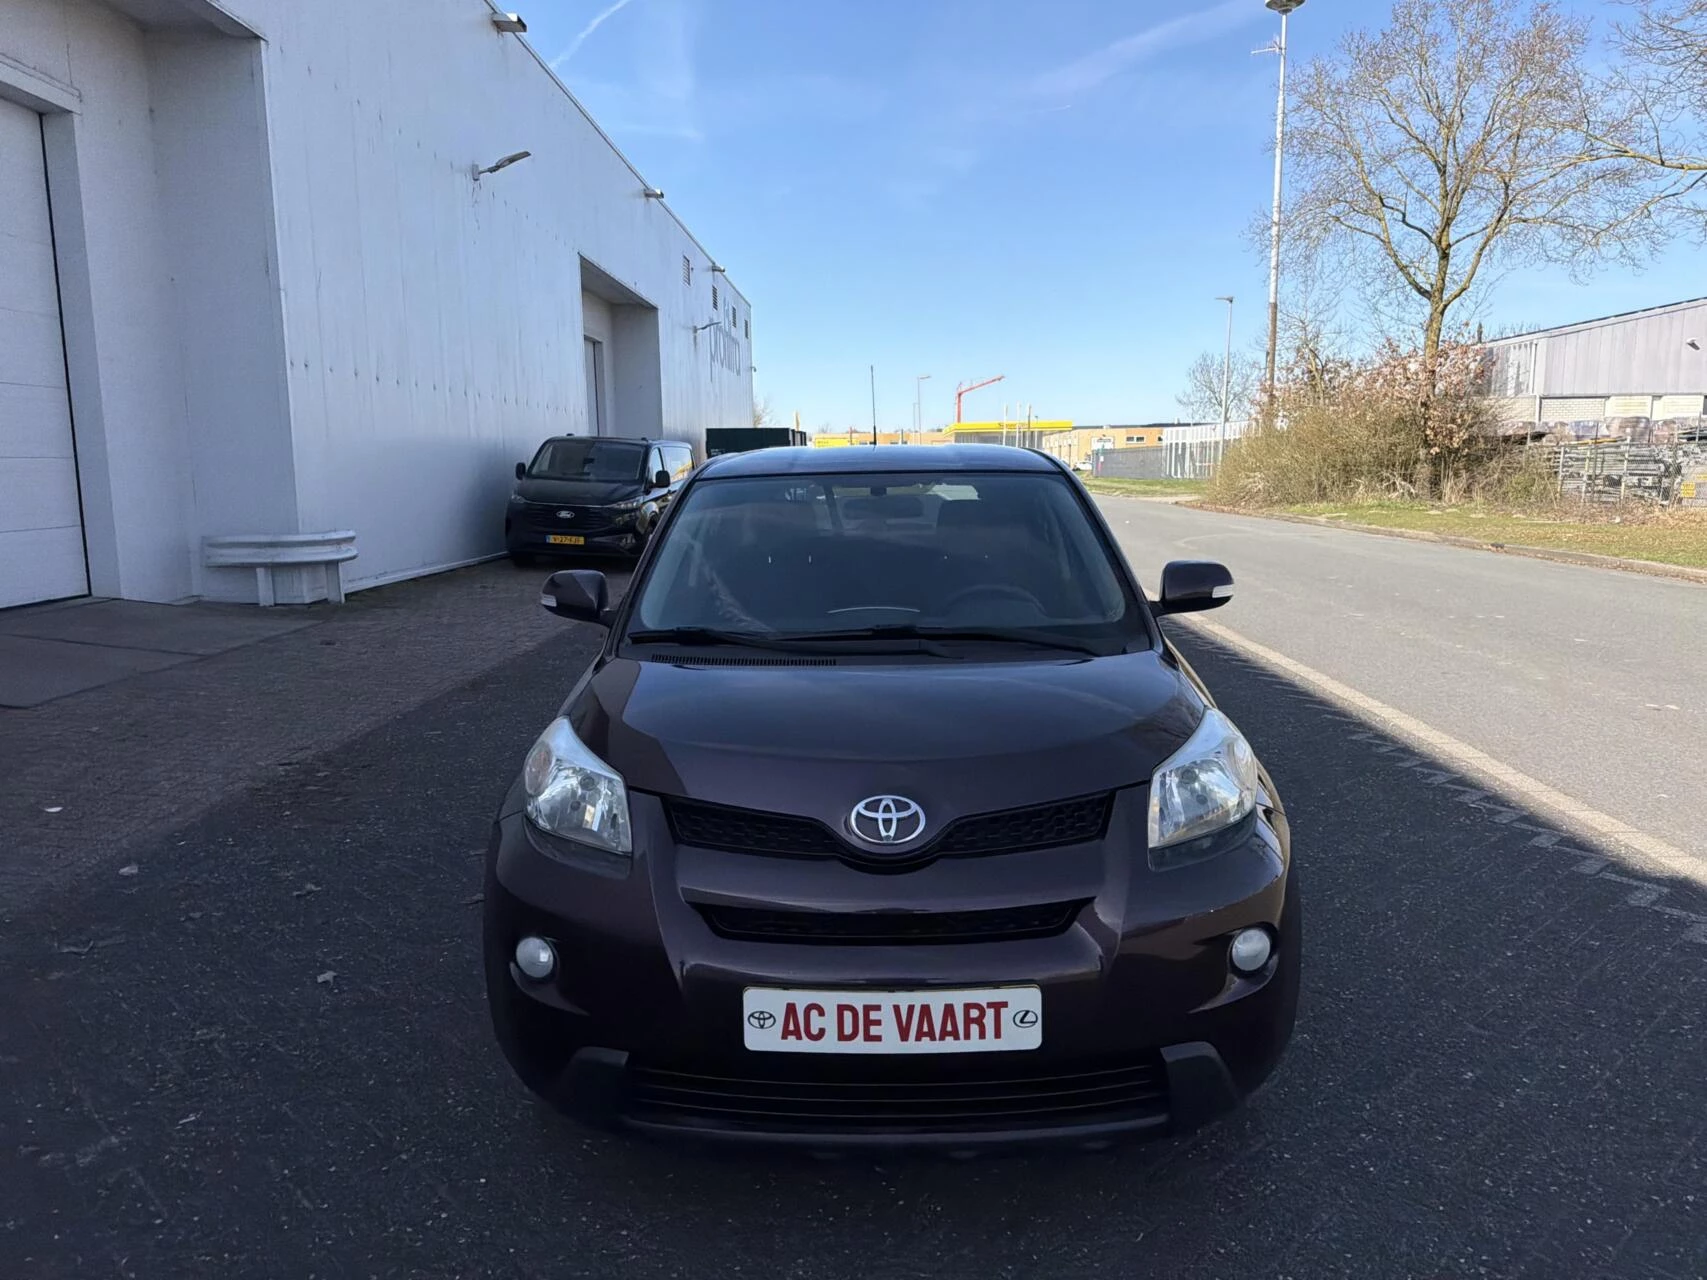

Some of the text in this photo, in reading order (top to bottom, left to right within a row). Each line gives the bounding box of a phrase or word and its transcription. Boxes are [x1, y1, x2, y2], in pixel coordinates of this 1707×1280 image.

[781, 1002, 1008, 1042] AC DE VAART
